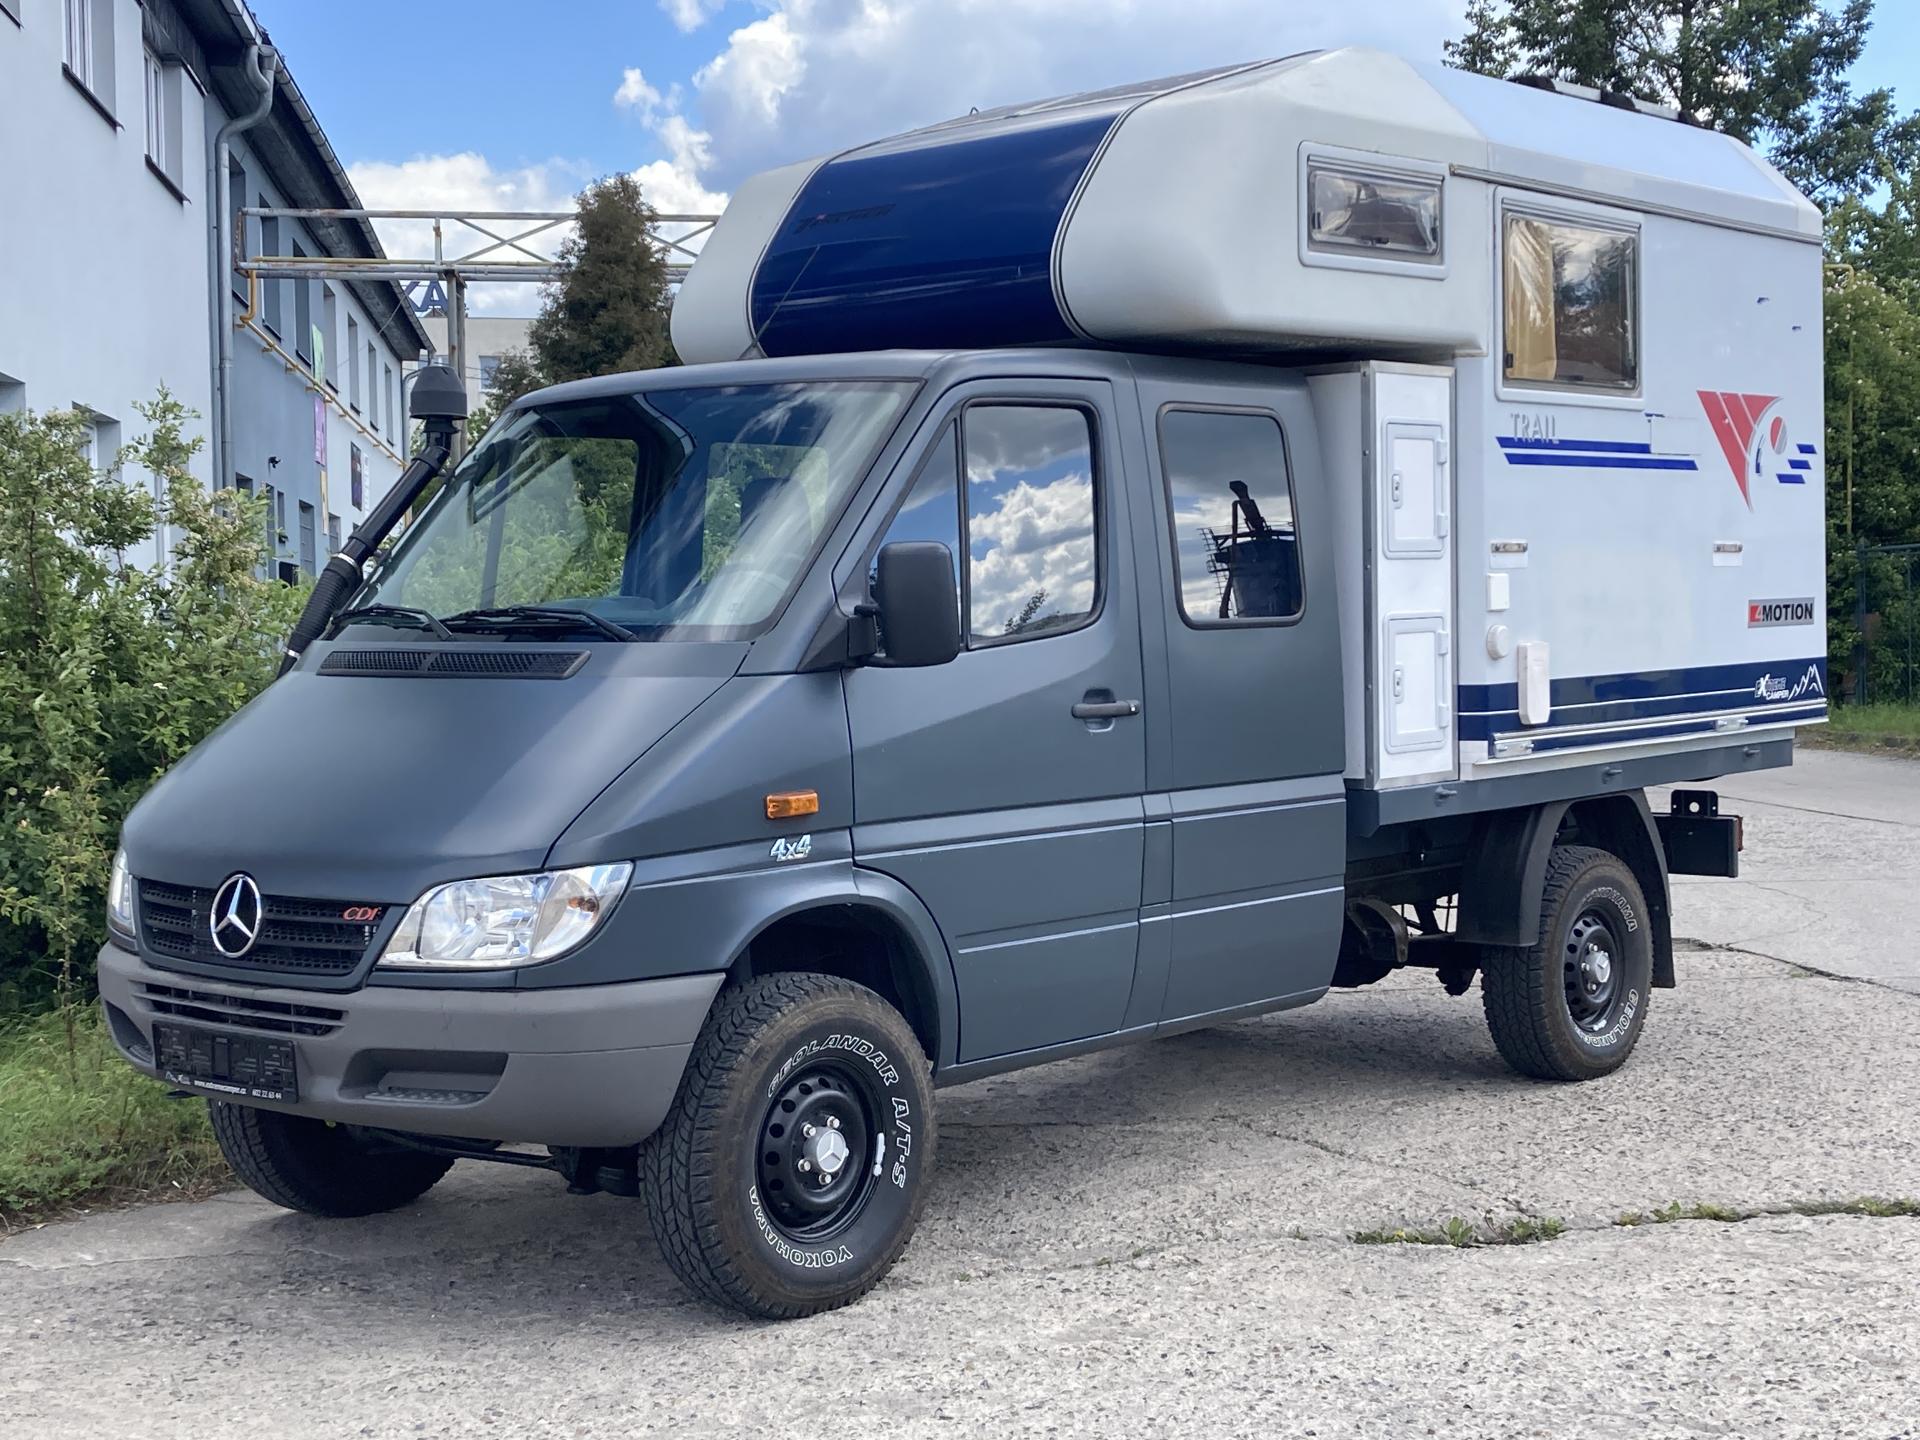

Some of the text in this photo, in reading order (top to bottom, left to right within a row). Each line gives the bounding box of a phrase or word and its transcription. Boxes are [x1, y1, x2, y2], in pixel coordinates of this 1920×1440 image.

[1510, 413, 1559, 444] TRAIL
[1749, 603, 1813, 622] 4MOTION
[770, 834, 812, 862] 4x4
[343, 906, 379, 921] CDI
[767, 1034, 900, 1098] GEOLANDAR
[749, 1185, 854, 1268] YOKOHAMA
